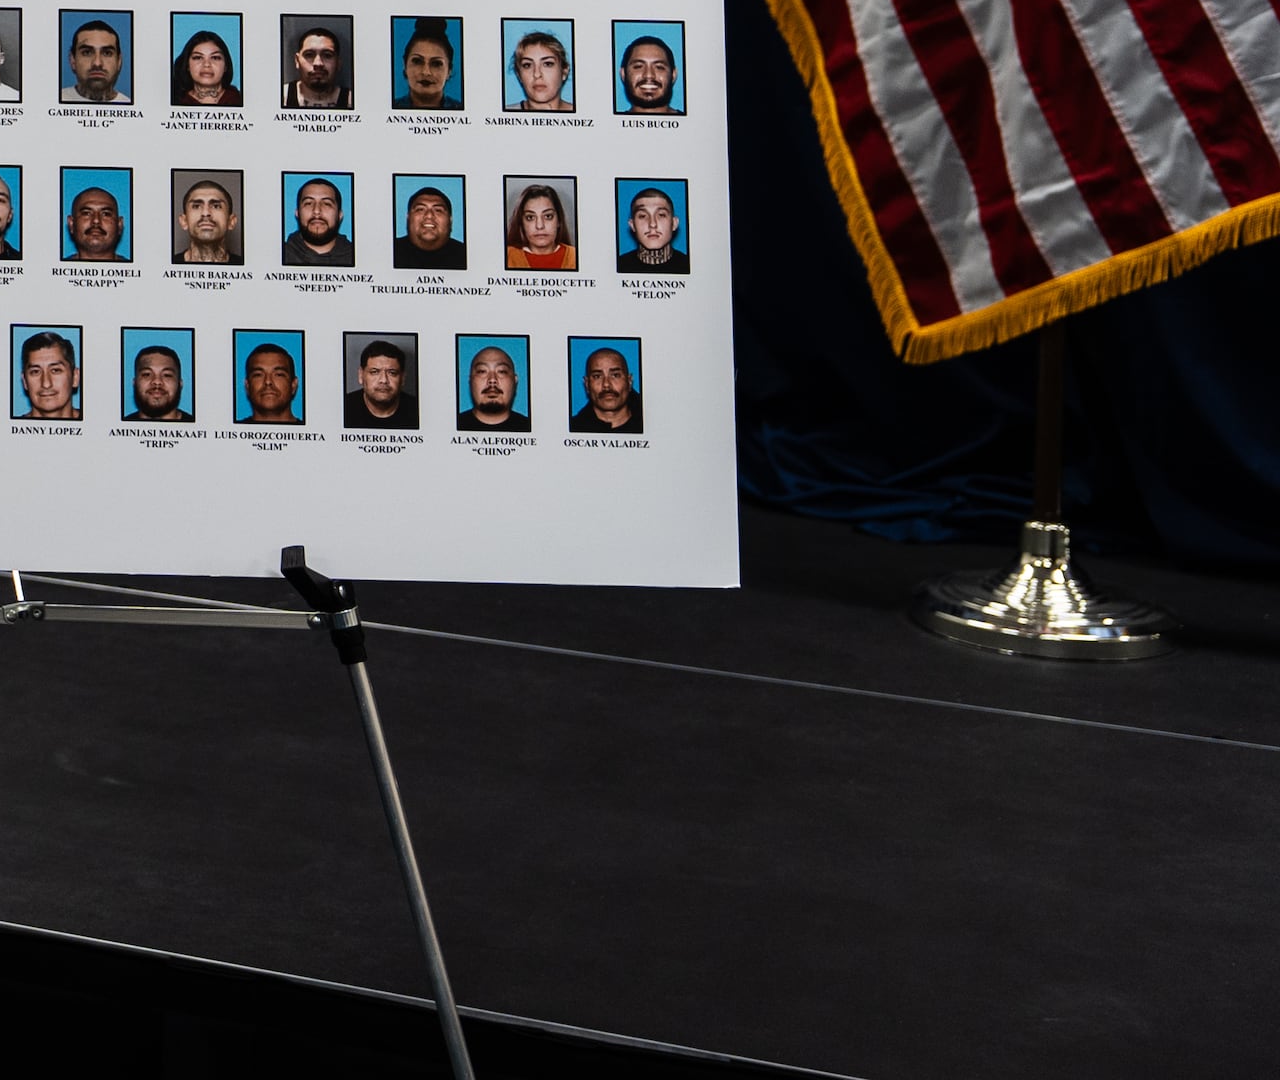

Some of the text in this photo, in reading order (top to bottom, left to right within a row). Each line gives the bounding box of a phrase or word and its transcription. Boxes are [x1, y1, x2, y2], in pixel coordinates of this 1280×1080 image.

[47, 108, 144, 118] GABRIEL HERRERA
[169, 110, 244, 121] JANET ZAPATA
[273, 112, 362, 123] ARMANDO LOPEZ
[385, 115, 472, 125] ANNA SANDOVAL
[484, 117, 594, 127] SABRINA HERNANDEZ
[621, 119, 679, 129] LUIS BUCIO
[51, 267, 141, 278] RICHARD LOMELI
[162, 269, 253, 280] ARTHUR BARAJAS
[263, 272, 374, 283] ANDREW HERNANDEZ
[415, 275, 445, 284] ADAN
[487, 276, 596, 288] DANIELLE DOUCETTE
[621, 279, 686, 289] KAI CANNON
[11, 425, 83, 436] DANNY LOPEZ
[214, 430, 238, 439] LUIS
[340, 433, 387, 443] HOMERO
[450, 435, 537, 447] ALAN ALFORQUE
[563, 438, 650, 449] OSCAR VALADEZ
